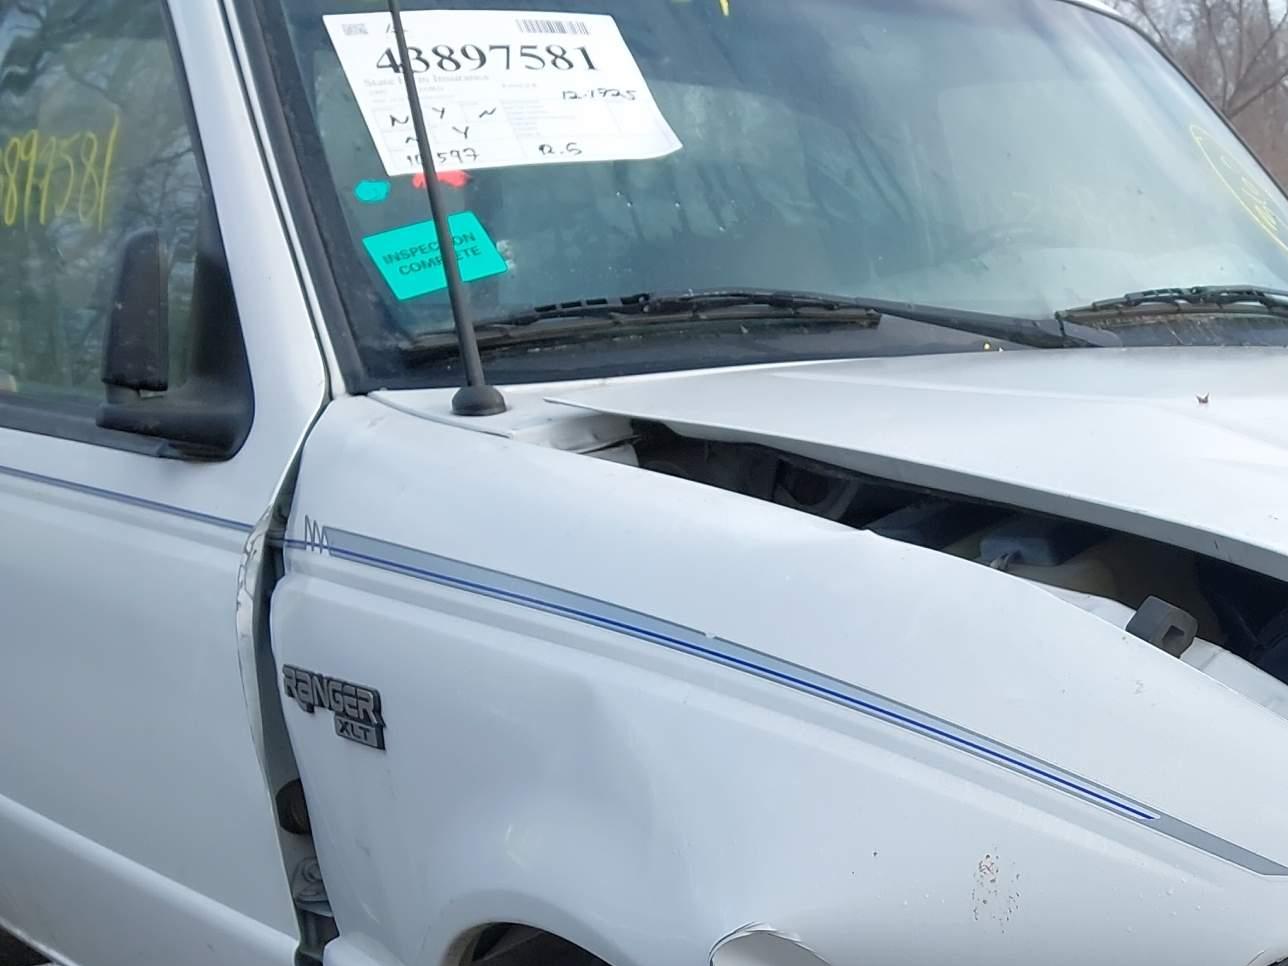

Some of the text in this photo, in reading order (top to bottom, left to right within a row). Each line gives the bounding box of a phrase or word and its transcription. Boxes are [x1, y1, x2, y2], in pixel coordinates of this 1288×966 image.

[376, 43, 600, 74] 43897581
[382, 232, 476, 264] INSPECON
[339, 719, 371, 742] XLT
